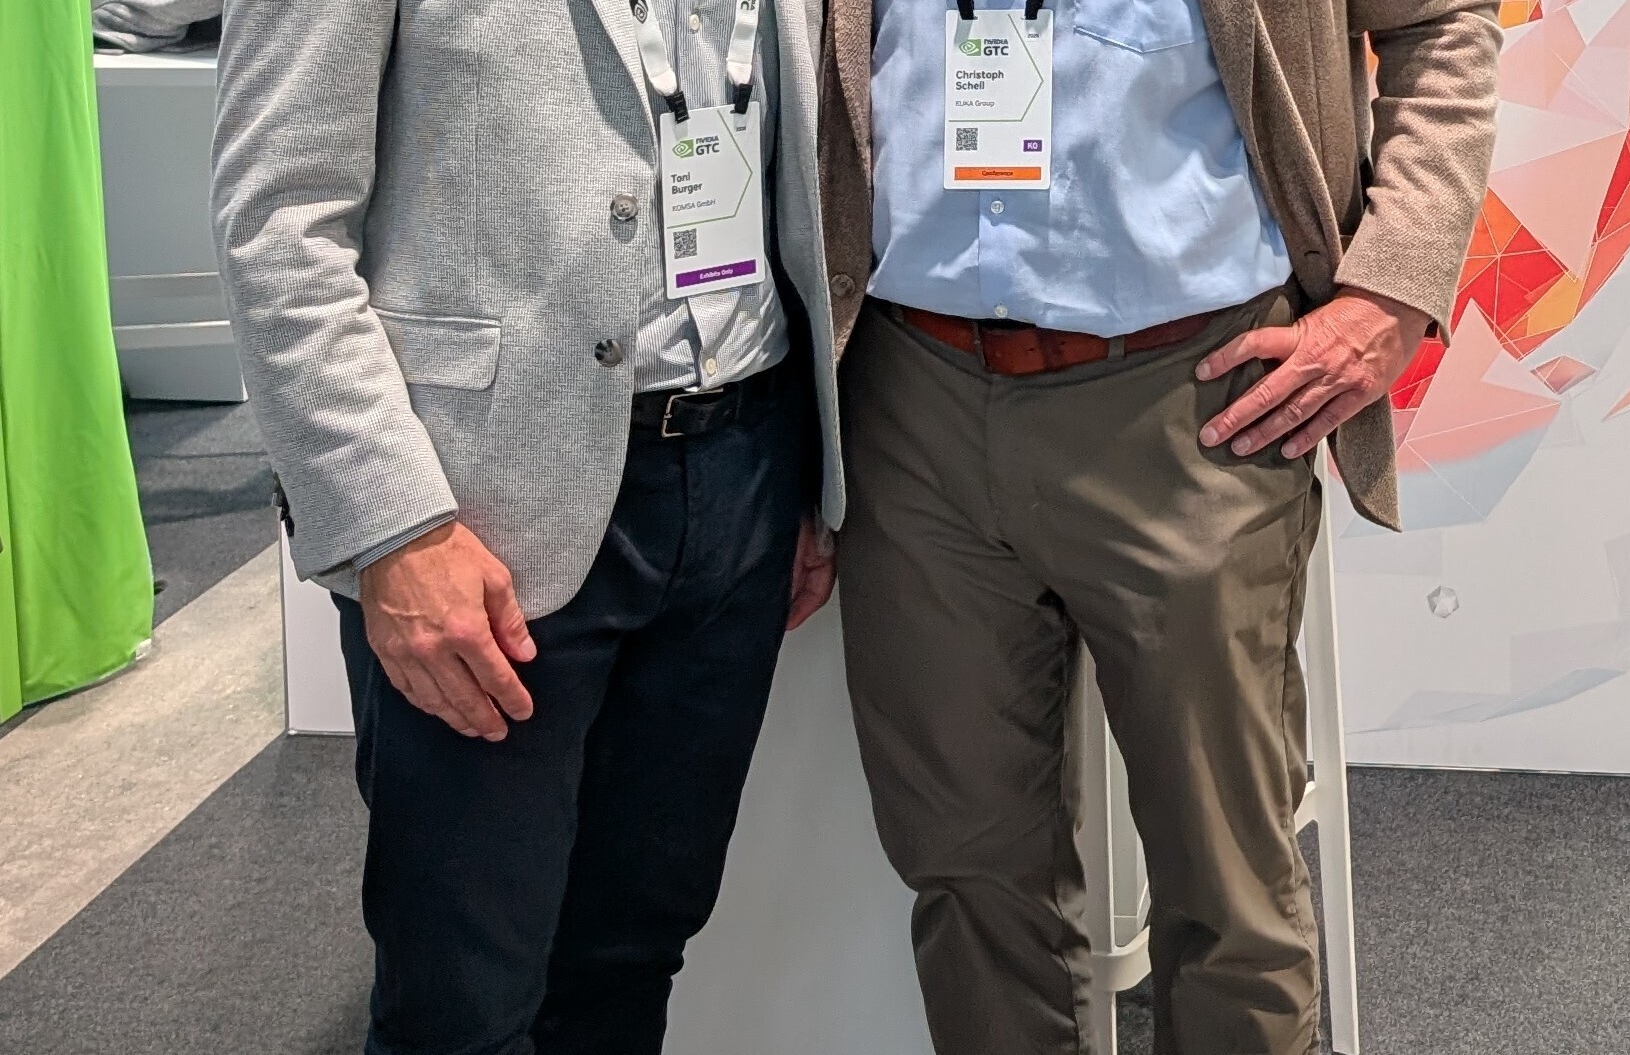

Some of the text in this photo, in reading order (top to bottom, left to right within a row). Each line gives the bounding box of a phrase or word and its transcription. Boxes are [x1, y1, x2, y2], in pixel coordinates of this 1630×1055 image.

[983, 45, 1009, 56] GTC
[956, 70, 1004, 81] Christoph
[955, 81, 985, 90] Schell
[695, 143, 720, 155] GTC
[671, 172, 691, 183] Toni
[672, 183, 703, 194] Burger
